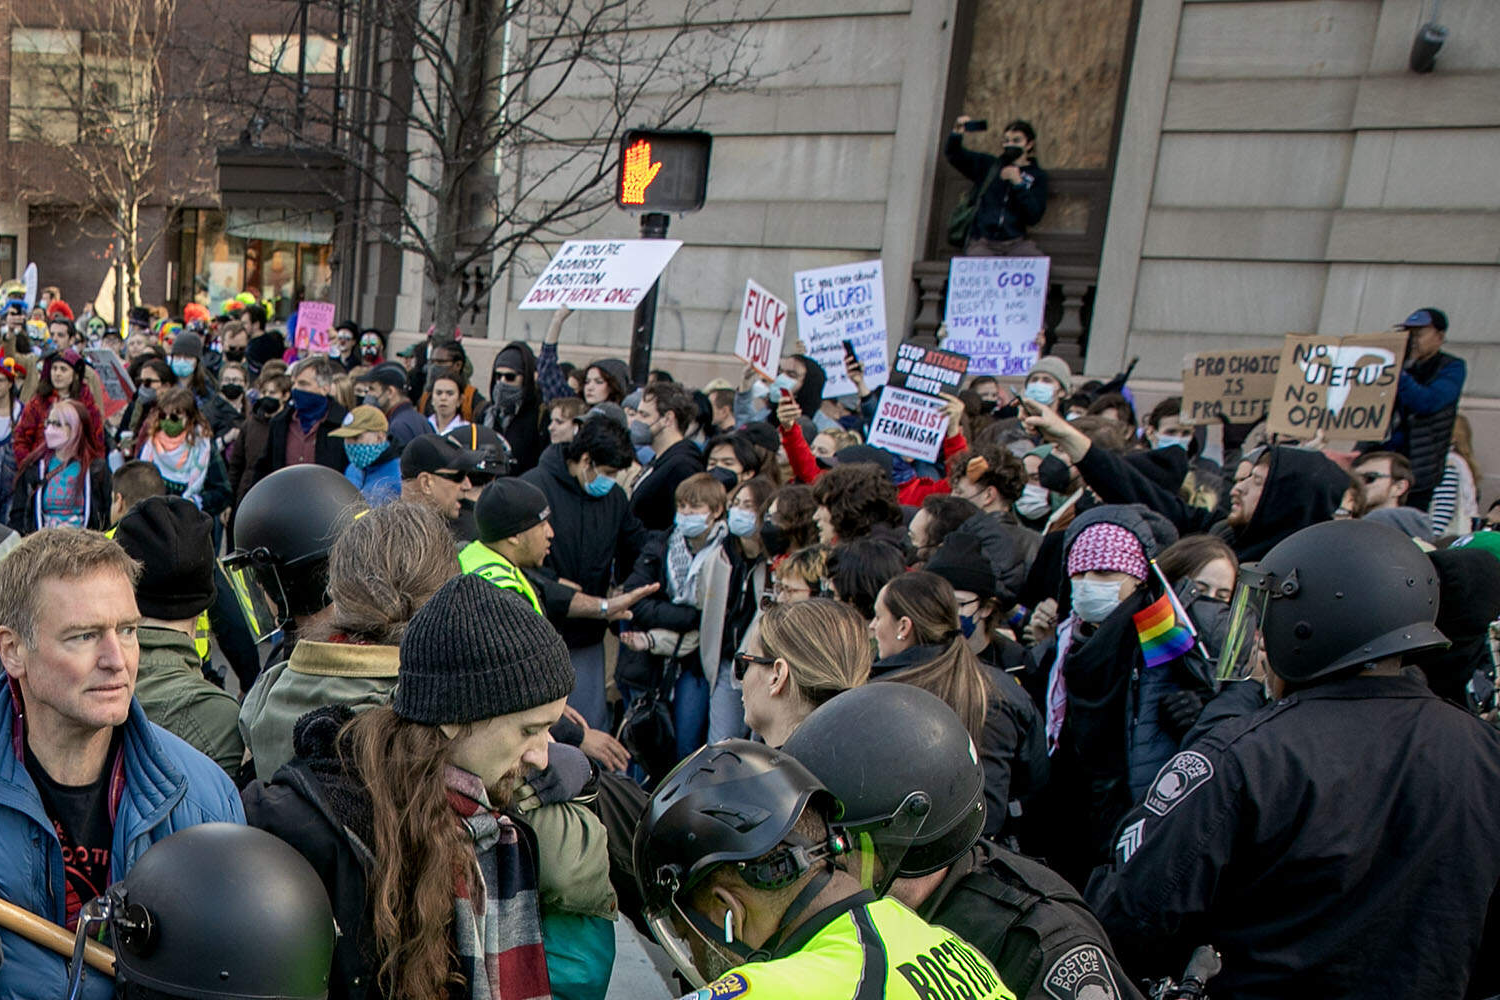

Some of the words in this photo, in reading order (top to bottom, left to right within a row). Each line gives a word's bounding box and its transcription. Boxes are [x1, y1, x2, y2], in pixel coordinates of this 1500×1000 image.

[551, 257, 607, 271] AGAINST
[539, 272, 607, 286] ABORTION
[997, 271, 1035, 288] GOD
[744, 288, 785, 338] FUCK
[976, 327, 1000, 337] ALL
[747, 327, 771, 368] YOU
[898, 343, 926, 361] STOP
[896, 357, 913, 374] ON
[910, 361, 962, 386] ABORTION
[1194, 357, 1226, 376] PRO
[1228, 355, 1280, 375] CHOIC
[1304, 363, 1396, 387] UTERUS
[1223, 378, 1244, 396] IS
[882, 401, 945, 430] SOCIALIST
[1191, 400, 1223, 418] PRO
[1288, 404, 1386, 431] OPINION
[876, 418, 940, 446] FEMINISM
[1050, 950, 1099, 986] BOSTON
[1061, 960, 1100, 991] POLICE
